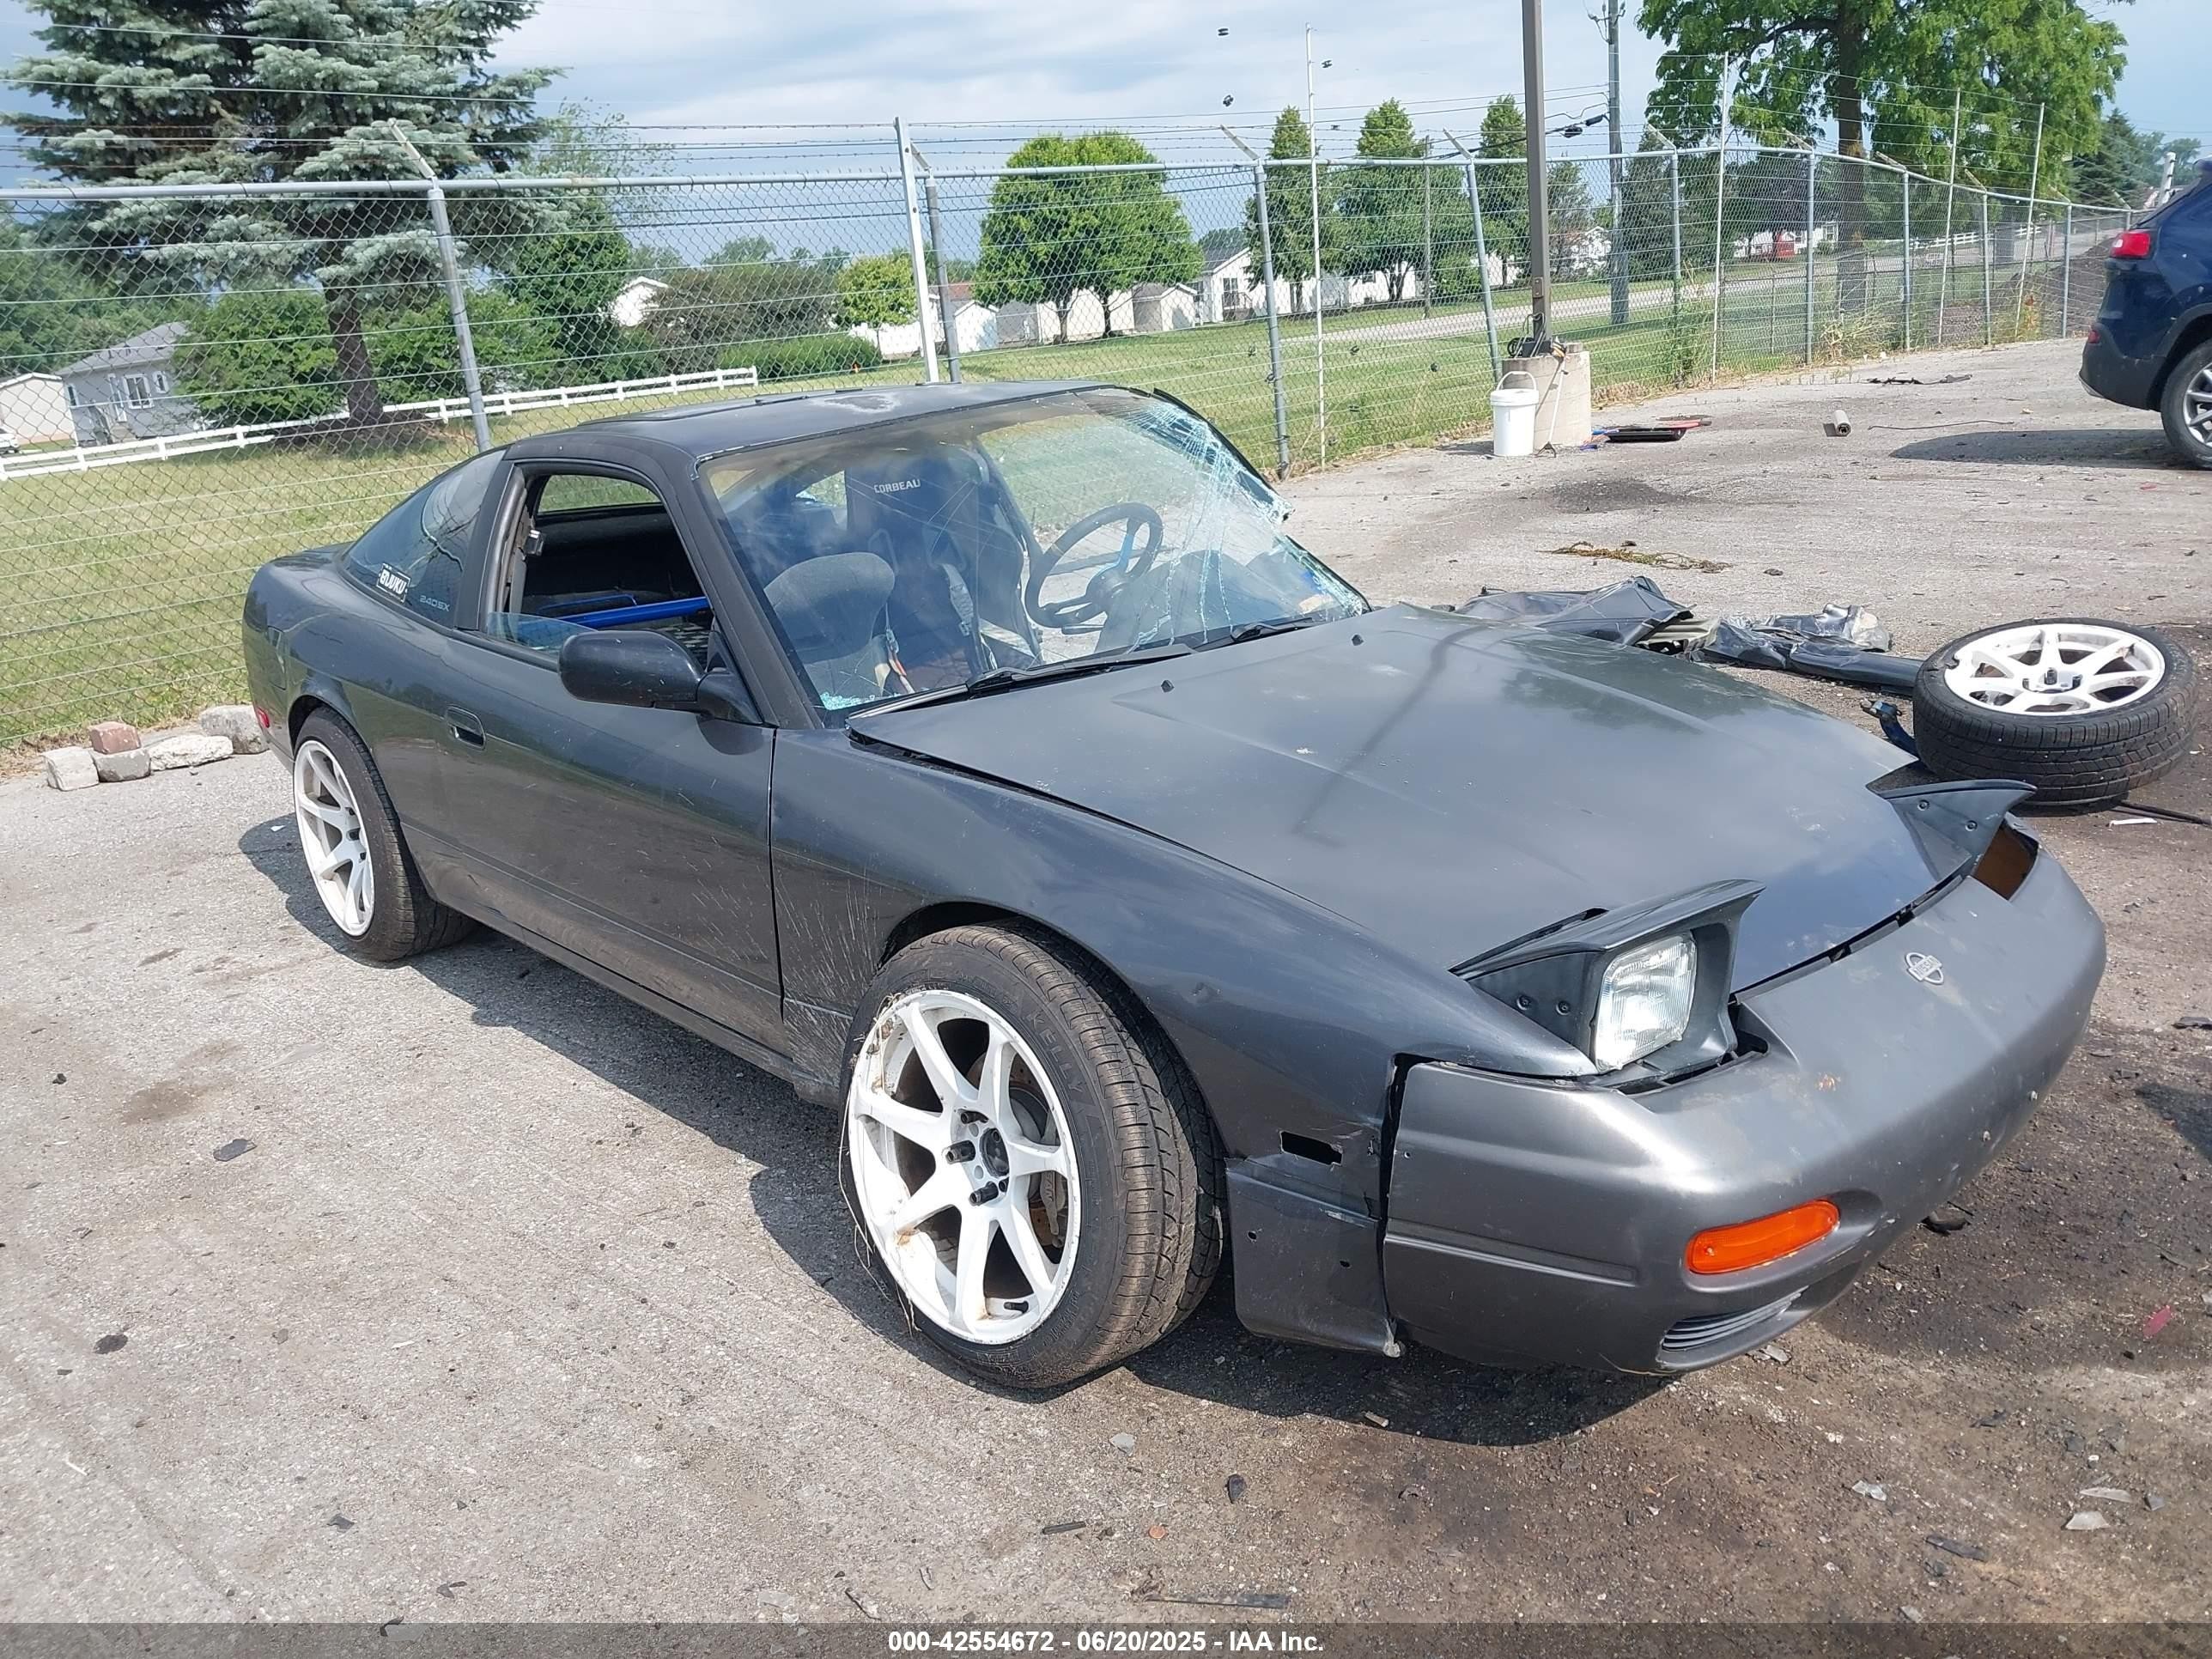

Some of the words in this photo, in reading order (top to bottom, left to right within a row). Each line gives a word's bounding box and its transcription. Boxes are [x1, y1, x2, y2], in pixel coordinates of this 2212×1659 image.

[874, 479, 921, 494] CORBEAU
[420, 595, 450, 611] 240SX
[1025, 1010, 1085, 1093] KELLY
